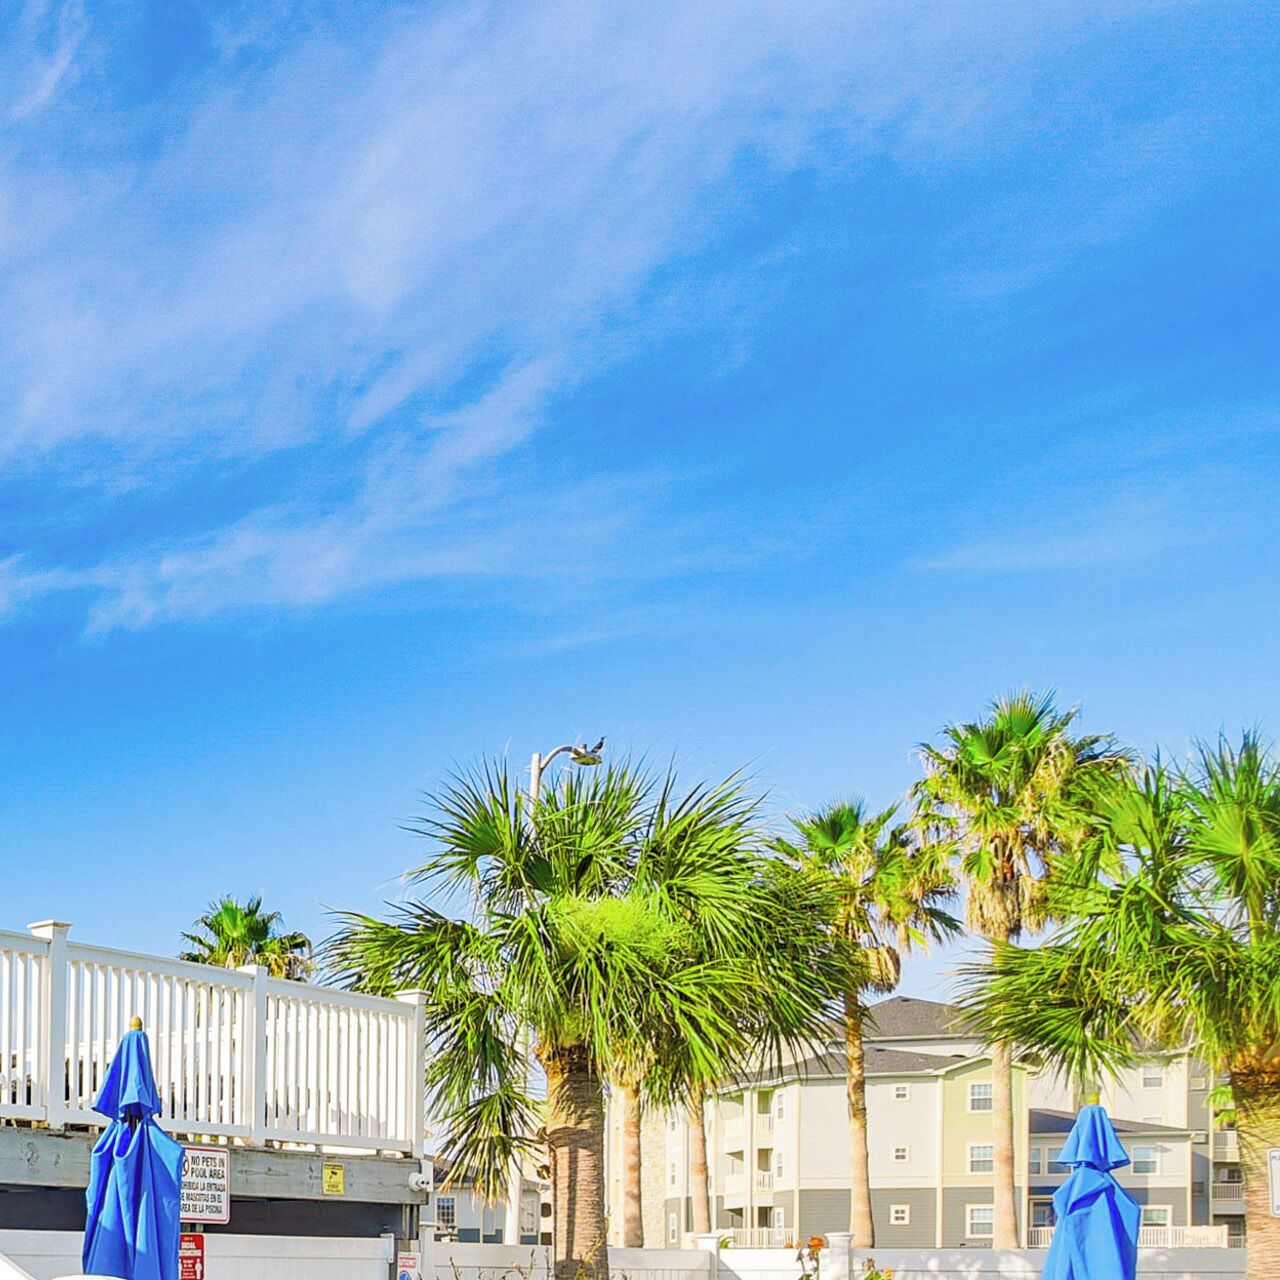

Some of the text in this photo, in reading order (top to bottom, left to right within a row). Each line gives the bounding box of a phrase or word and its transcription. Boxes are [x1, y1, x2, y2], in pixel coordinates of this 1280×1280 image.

[191, 1155, 225, 1168] NO PETS IN
[191, 1167, 225, 1179] POOL AREA
